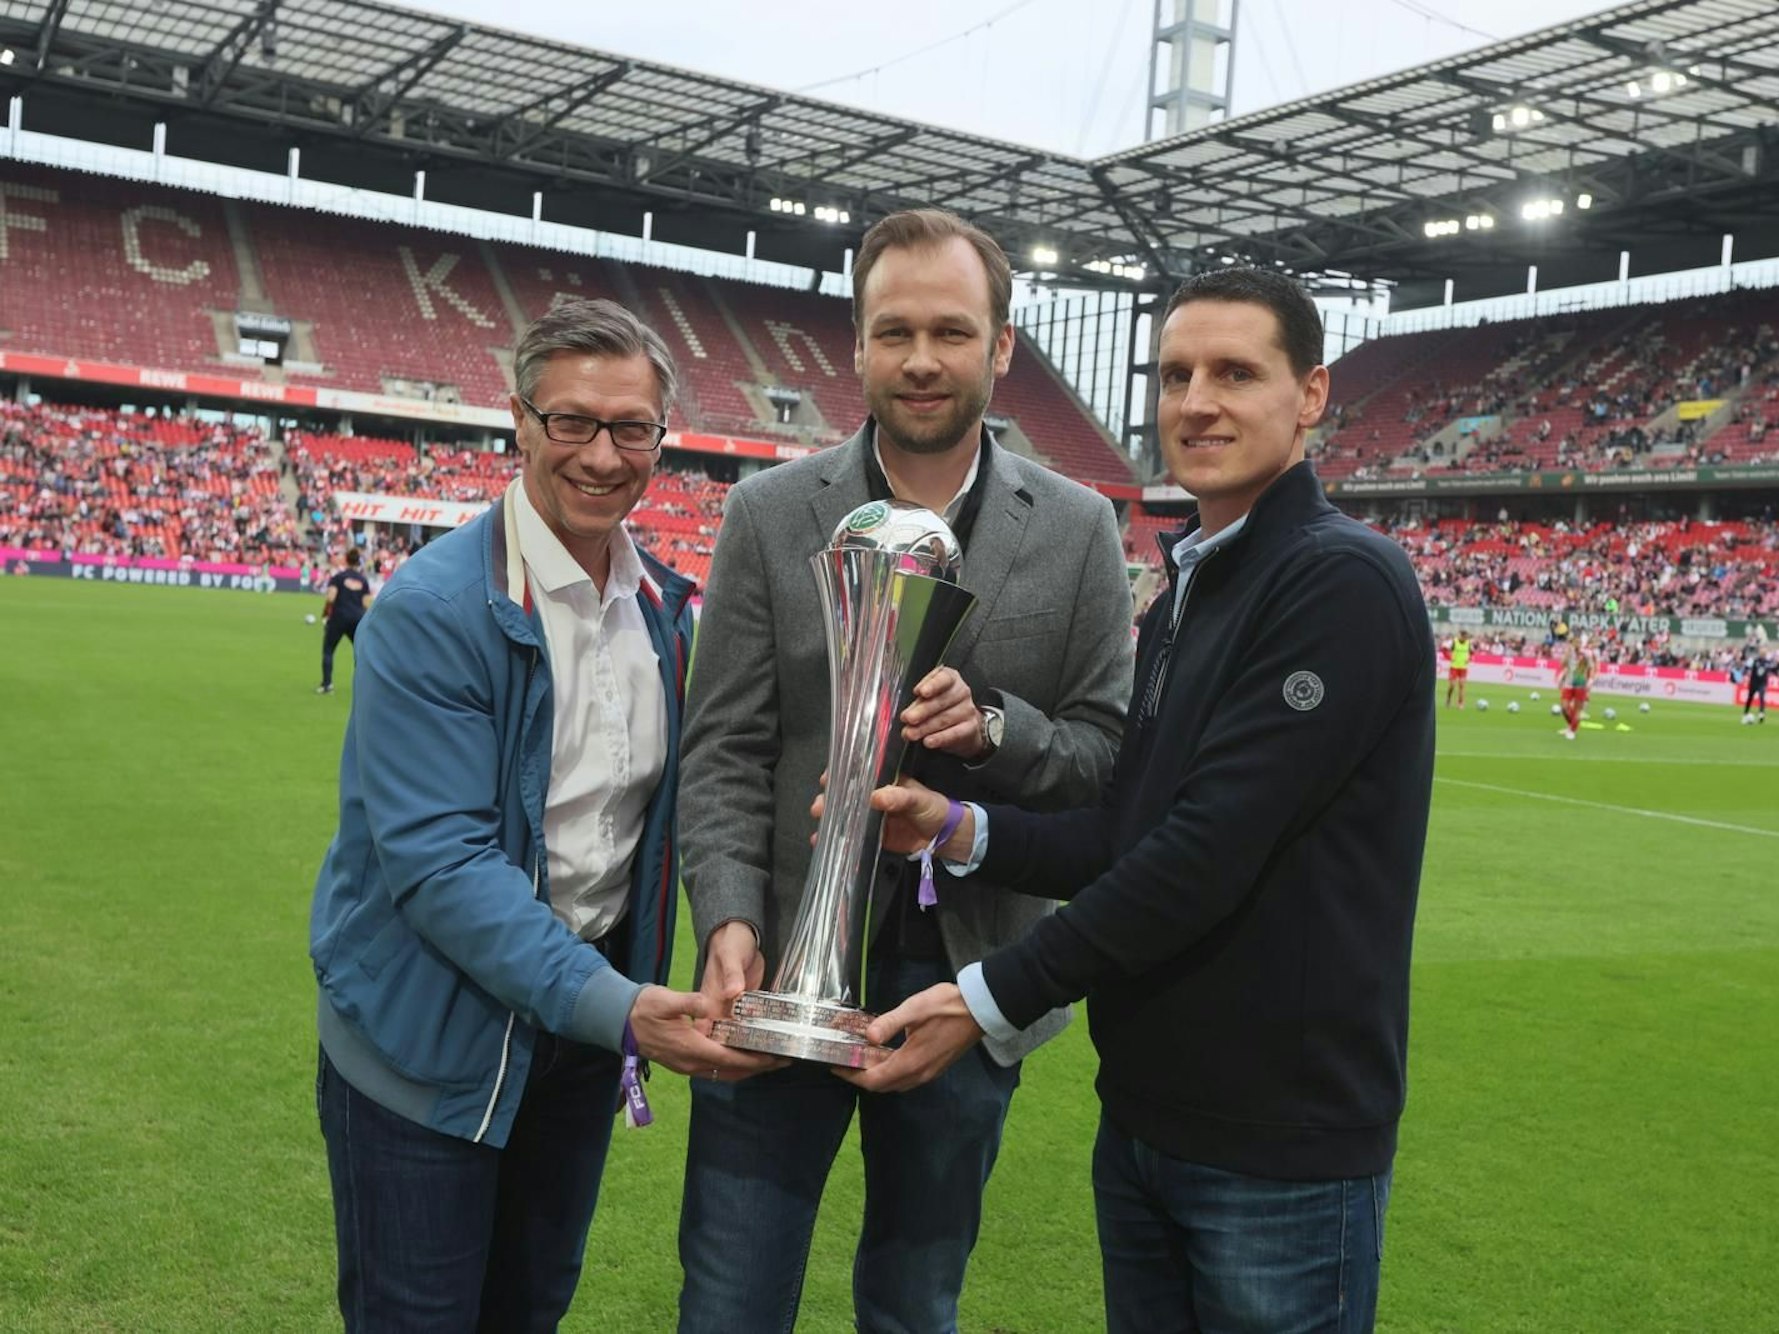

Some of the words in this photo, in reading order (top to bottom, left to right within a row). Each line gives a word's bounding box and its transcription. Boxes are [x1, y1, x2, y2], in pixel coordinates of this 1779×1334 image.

[342, 502, 385, 517] HIT
[400, 507, 443, 521] HIT
[102, 565, 190, 586] POWERED
[200, 572, 224, 588] BY
[1492, 609, 1561, 627] NATION
[630, 1085, 645, 1109] FC
